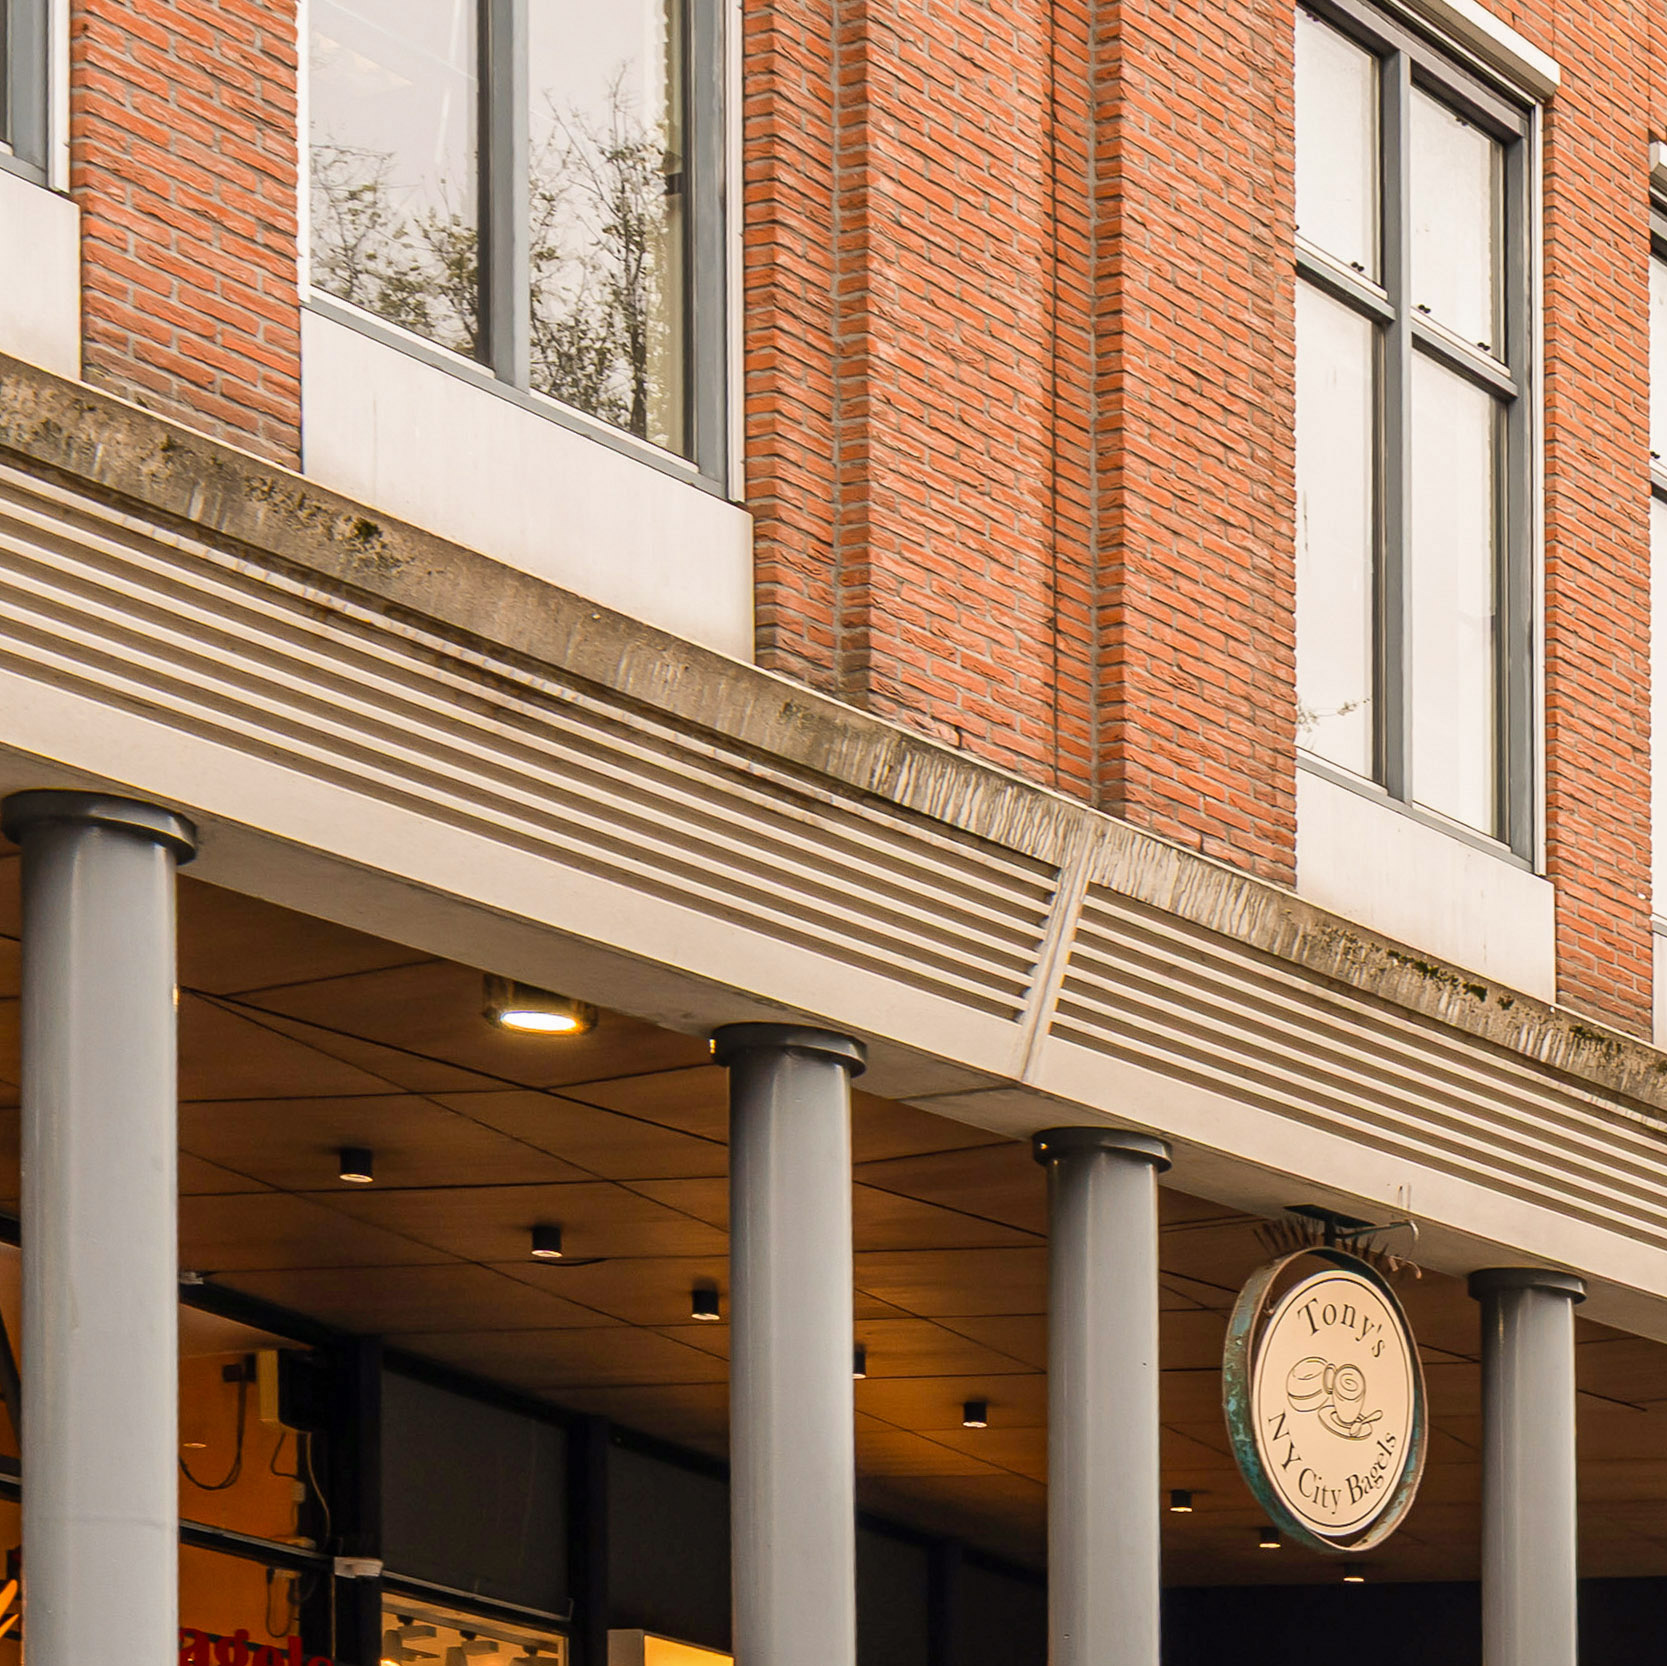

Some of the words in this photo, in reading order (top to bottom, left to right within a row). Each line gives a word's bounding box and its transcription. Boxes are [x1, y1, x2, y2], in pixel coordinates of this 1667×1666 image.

[1297, 1298, 1385, 1358] Tony's
[1268, 1410, 1302, 1471] NY
[1297, 1468, 1343, 1515] City
[1344, 1431, 1398, 1507] Bagels
